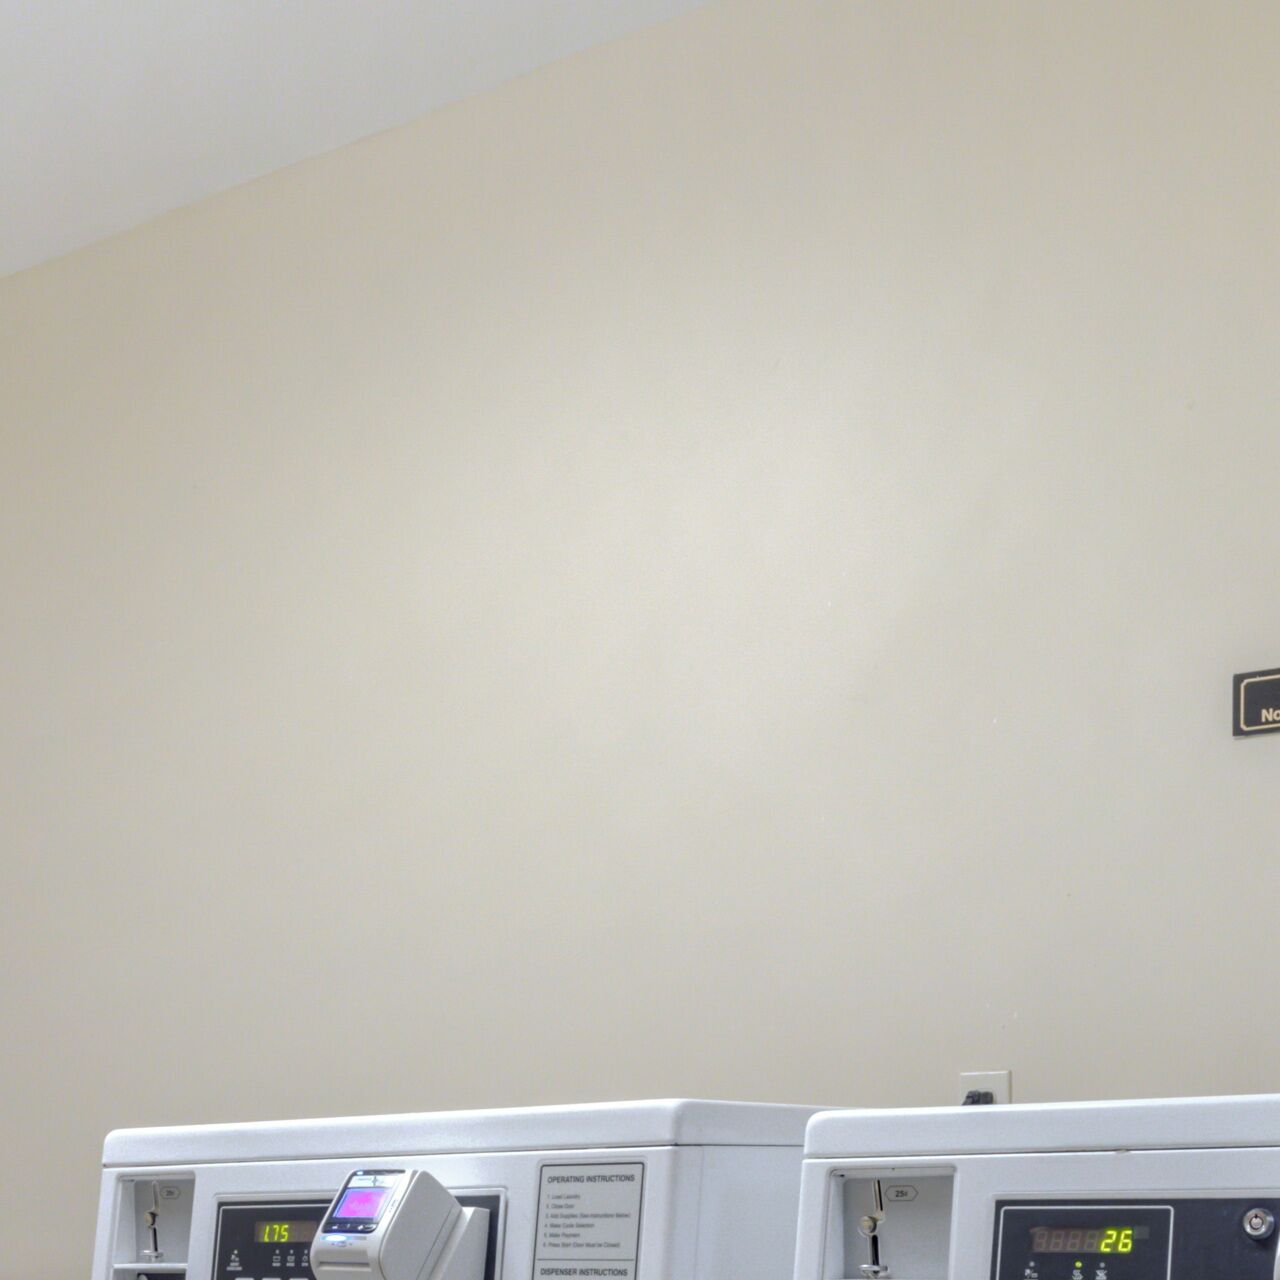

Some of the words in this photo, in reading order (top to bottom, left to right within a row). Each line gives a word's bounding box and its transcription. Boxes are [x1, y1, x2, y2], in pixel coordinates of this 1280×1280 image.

[547, 1175, 585, 1183] OPERATING
[586, 1174, 635, 1183] INSTRUCTIONS
[1100, 1229, 1133, 1253] 26
[540, 1268, 578, 1276] DISPENSER
[579, 1268, 628, 1277] INSTRUCTIONS
